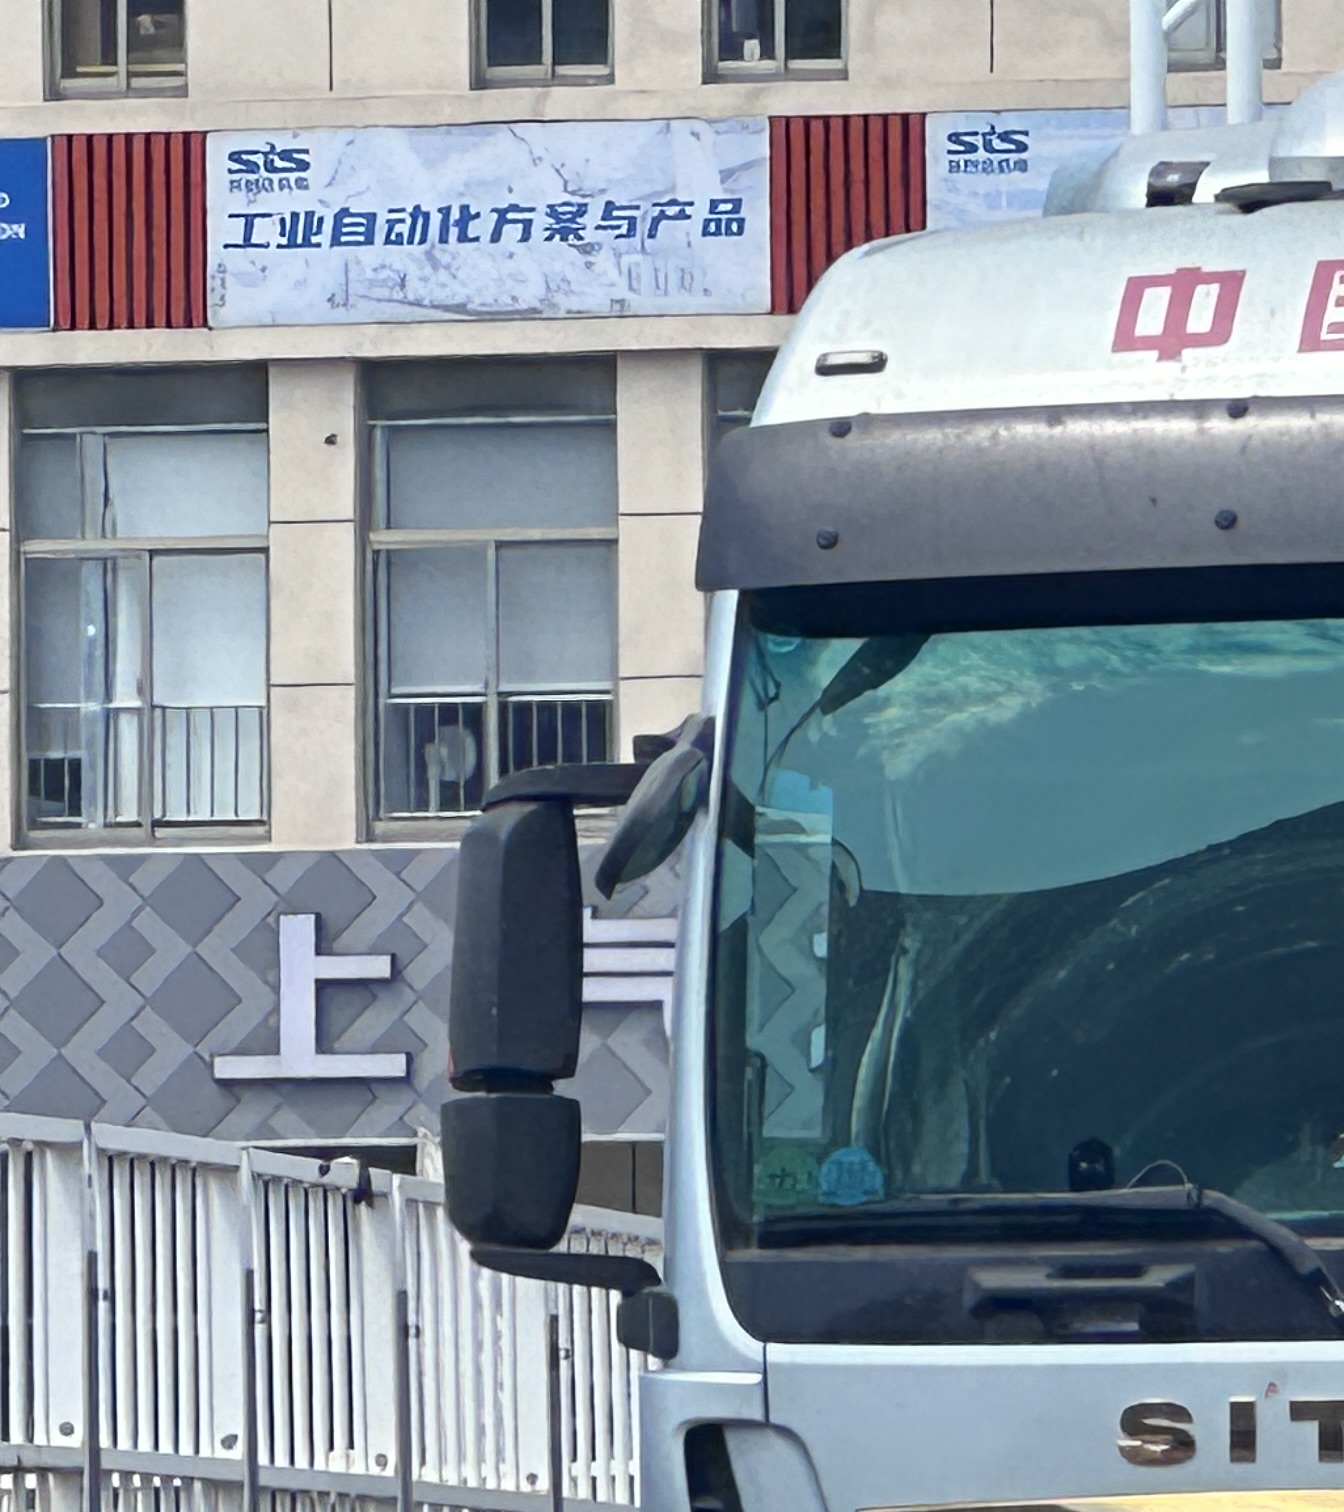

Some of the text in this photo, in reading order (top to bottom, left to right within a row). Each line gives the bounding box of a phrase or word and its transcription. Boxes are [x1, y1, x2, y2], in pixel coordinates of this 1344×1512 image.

[223, 198, 745, 249] 工业自动化方案与产品
